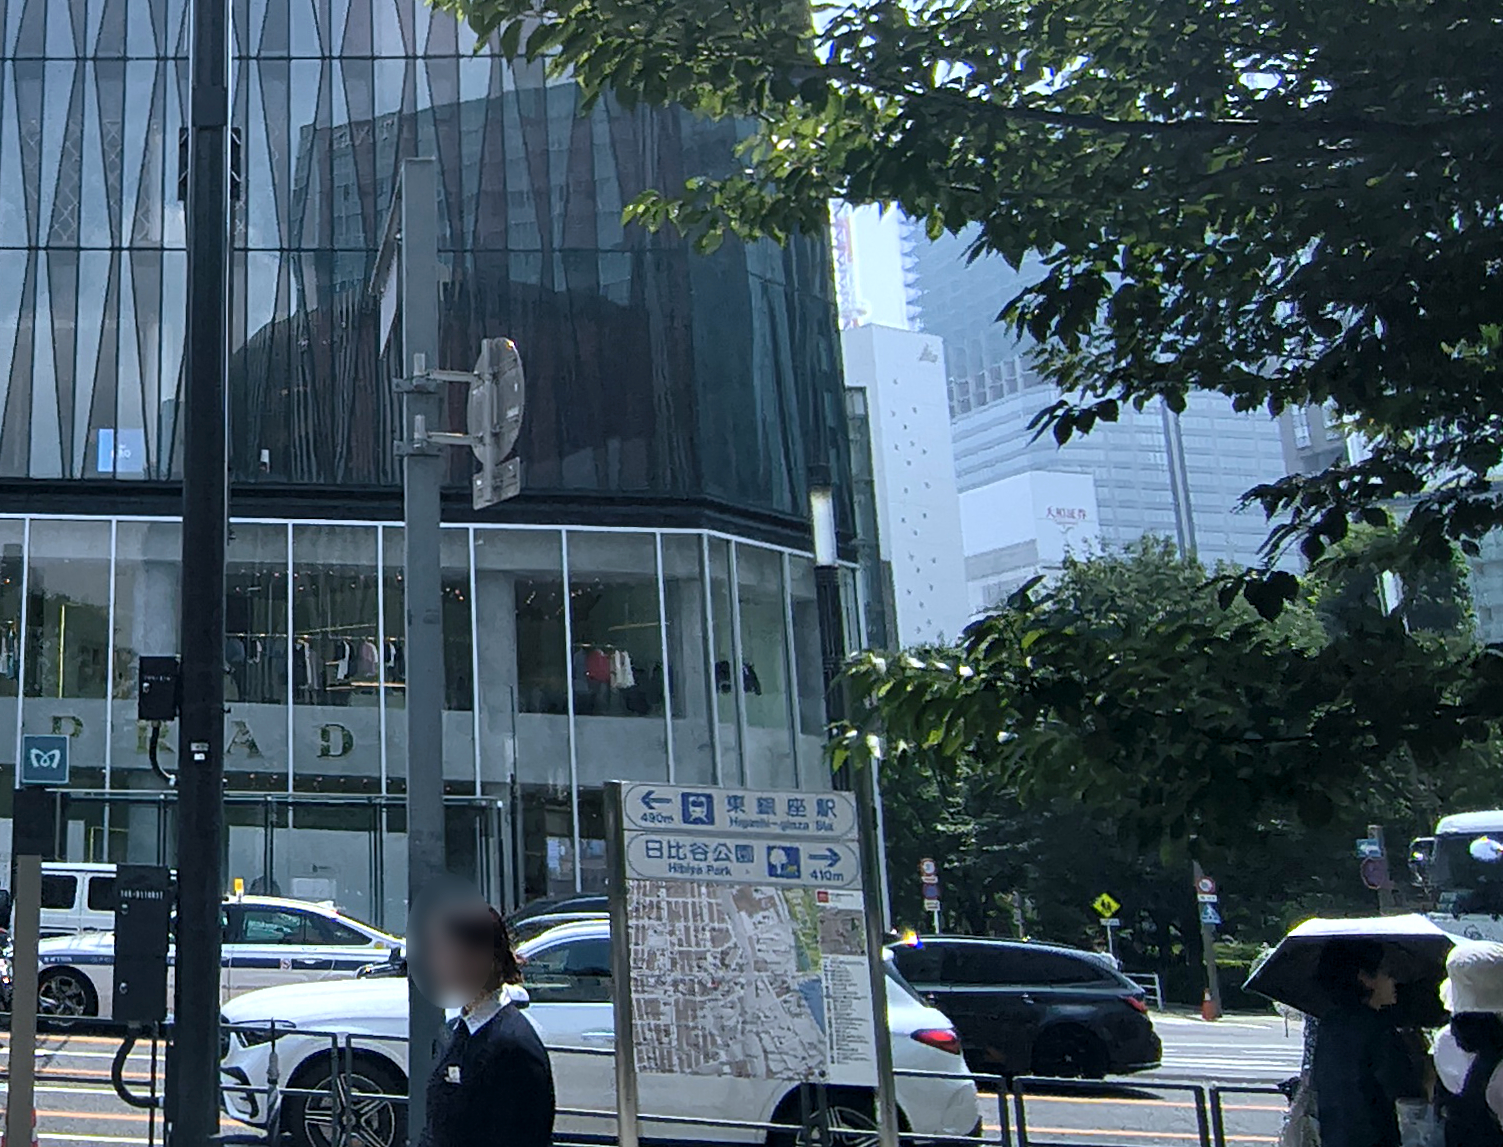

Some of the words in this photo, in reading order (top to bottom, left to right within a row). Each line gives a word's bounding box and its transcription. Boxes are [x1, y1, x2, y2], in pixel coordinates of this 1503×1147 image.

[49, 715, 355, 758] PRAD
[726, 793, 838, 819] 東銀座駅
[639, 812, 675, 825] 490m
[644, 838, 755, 865] 日比谷公園
[668, 862, 704, 876] Hibiya
[706, 864, 733, 877] Park
[809, 869, 845, 883] 410m
